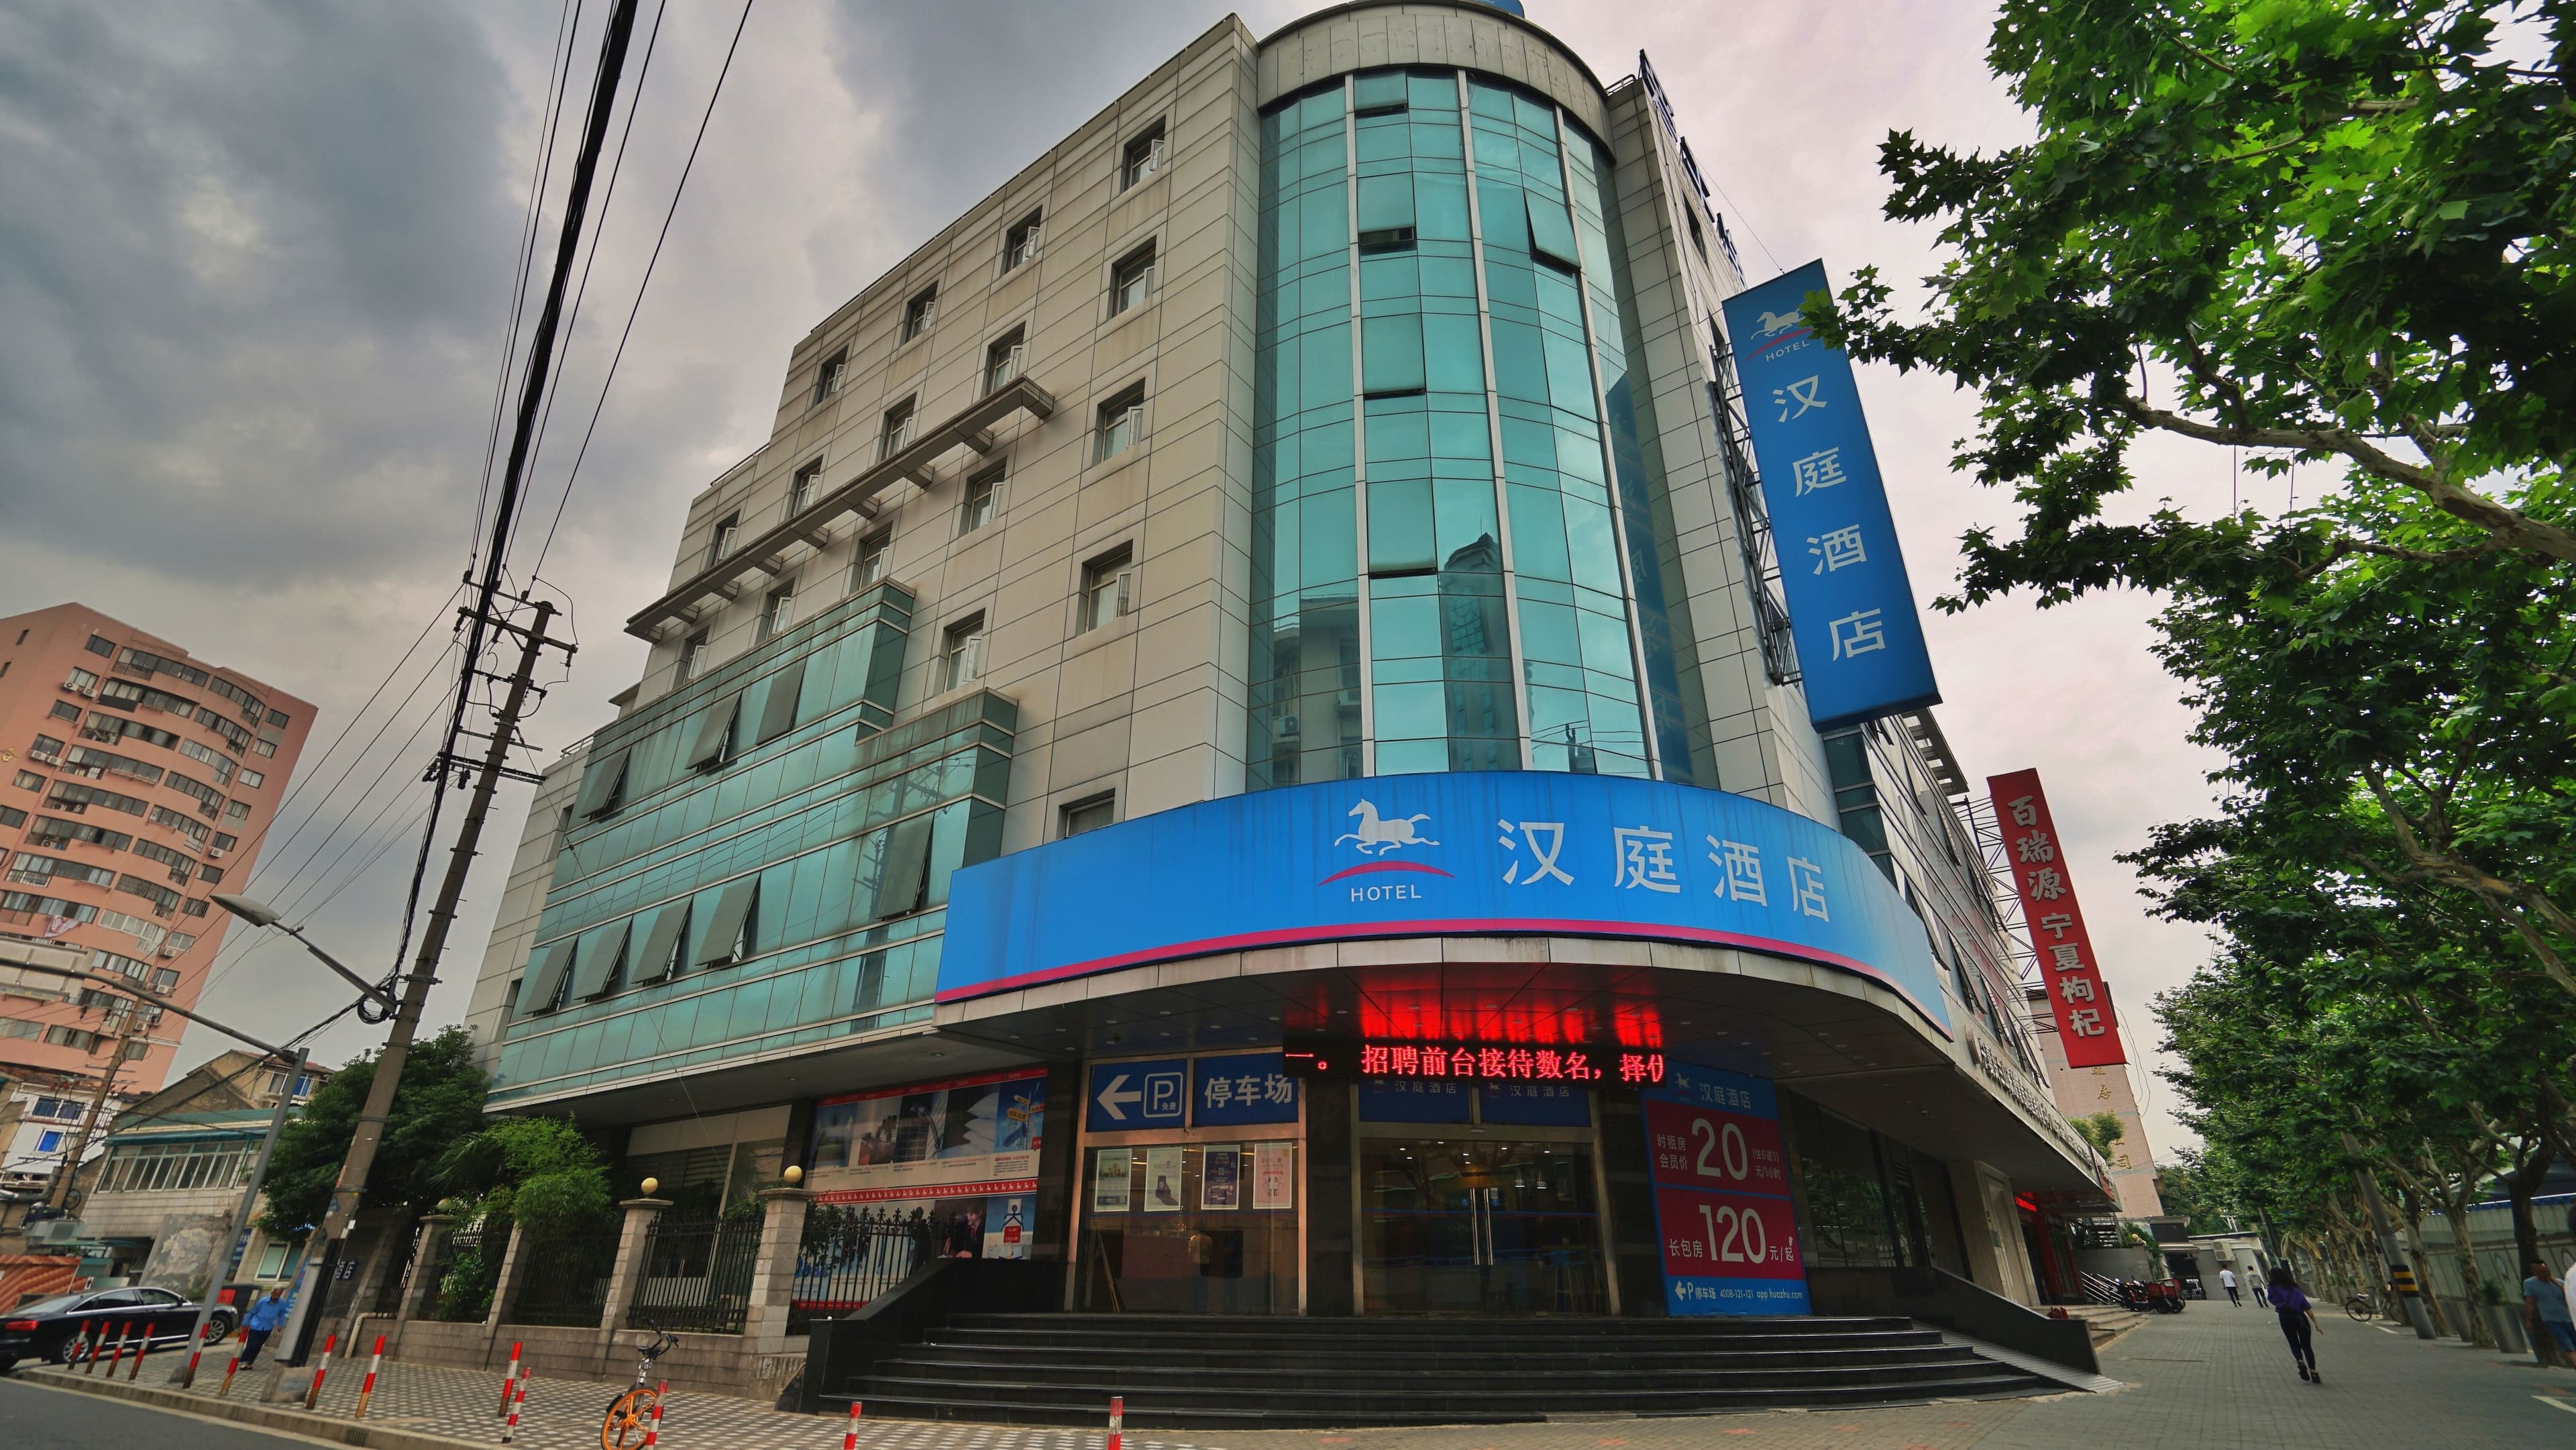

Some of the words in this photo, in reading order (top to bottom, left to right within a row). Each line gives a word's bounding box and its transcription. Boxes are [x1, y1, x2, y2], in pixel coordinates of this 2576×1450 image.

[1766, 340, 1809, 362] HOTEL
[1772, 374, 1886, 661] 汉庭酒店
[1497, 819, 1830, 923] 汉庭酒店
[1350, 884, 1422, 902] HOTEL
[2007, 795, 2105, 1037] 百瑞源宁夏枸杞
[1153, 1081, 1173, 1110] P
[1204, 1074, 1292, 1108] 停车场
[1395, 1080, 1456, 1094] 汉庭酒店
[1510, 1085, 1569, 1098] 汉庭酒店
[1699, 1082, 1751, 1109] 汉庭酒店
[1656, 1134, 1686, 1151] 时租房
[1691, 1118, 1748, 1181] 20
[1659, 1153, 1688, 1171] 会员价
[1699, 1204, 1766, 1264] 120
[1669, 1239, 1703, 1258] 长包房
